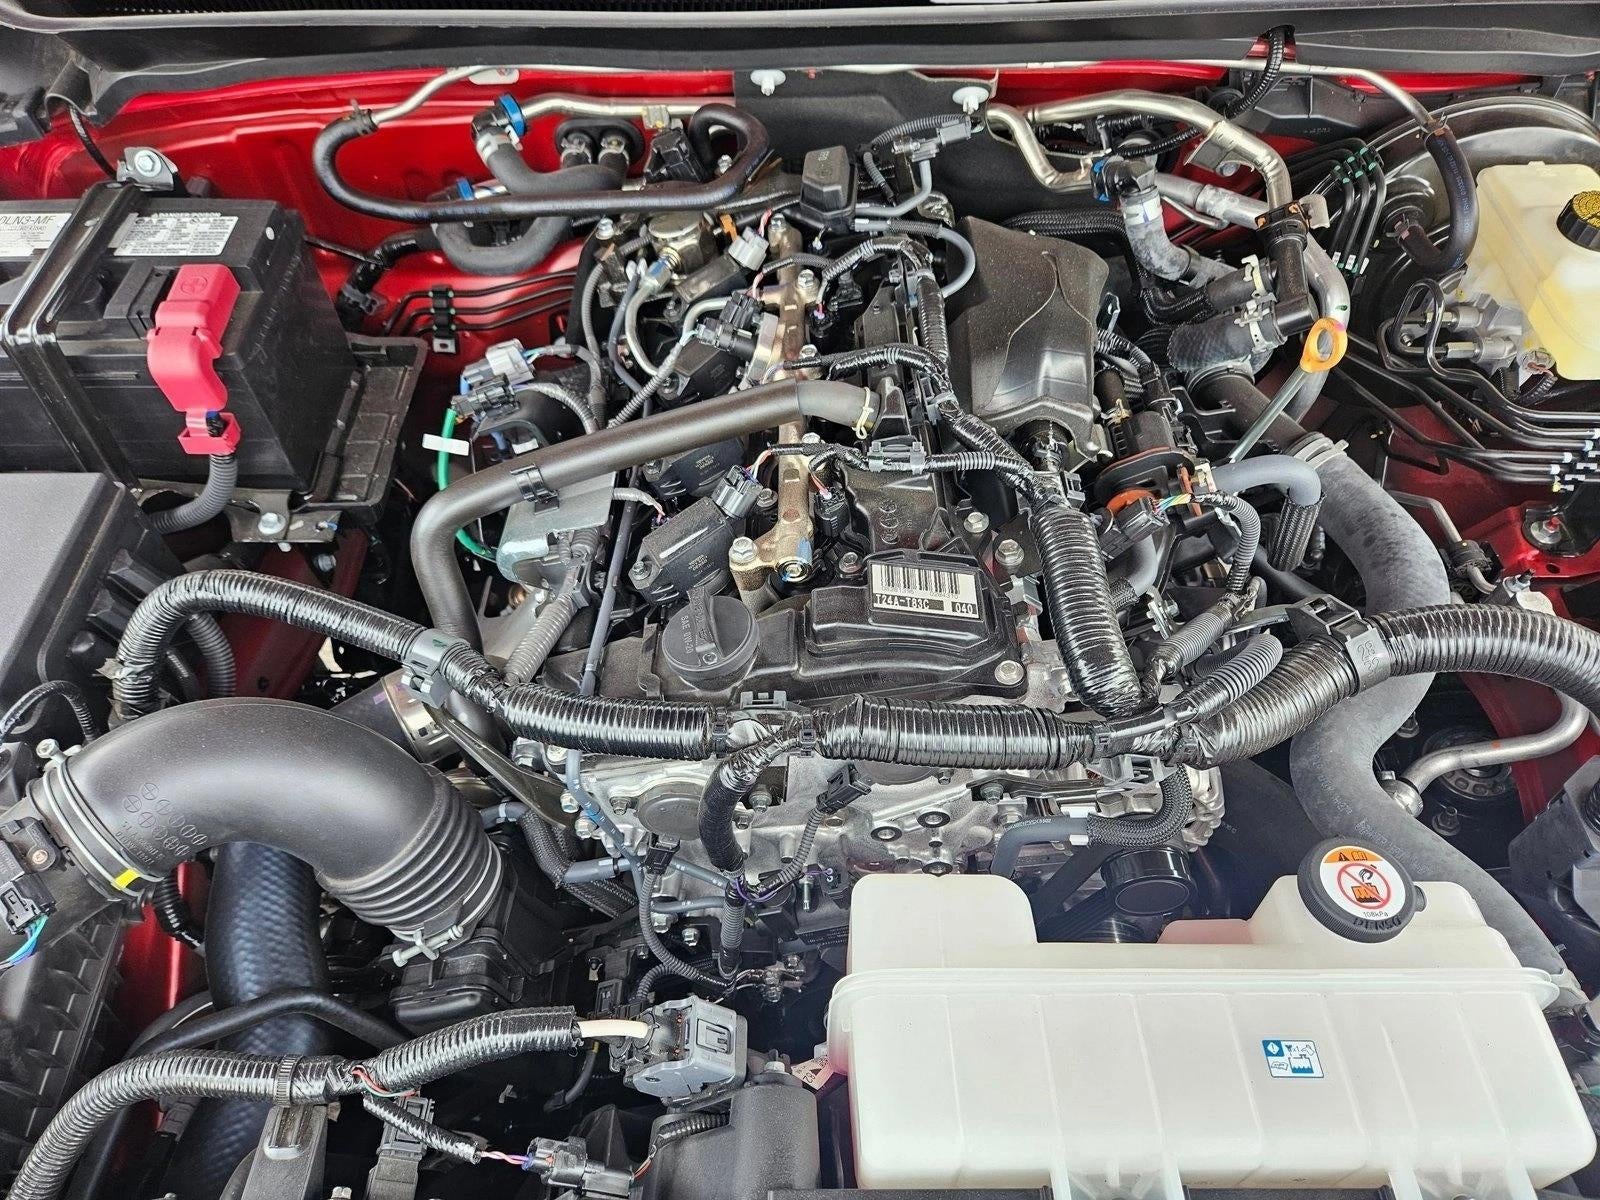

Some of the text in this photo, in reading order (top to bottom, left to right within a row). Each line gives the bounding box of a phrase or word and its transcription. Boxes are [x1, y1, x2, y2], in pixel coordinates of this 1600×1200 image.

[955, 604, 973, 614] 040
[681, 615, 694, 654] SAE 0W-20
[1353, 915, 1402, 931] DENSO
